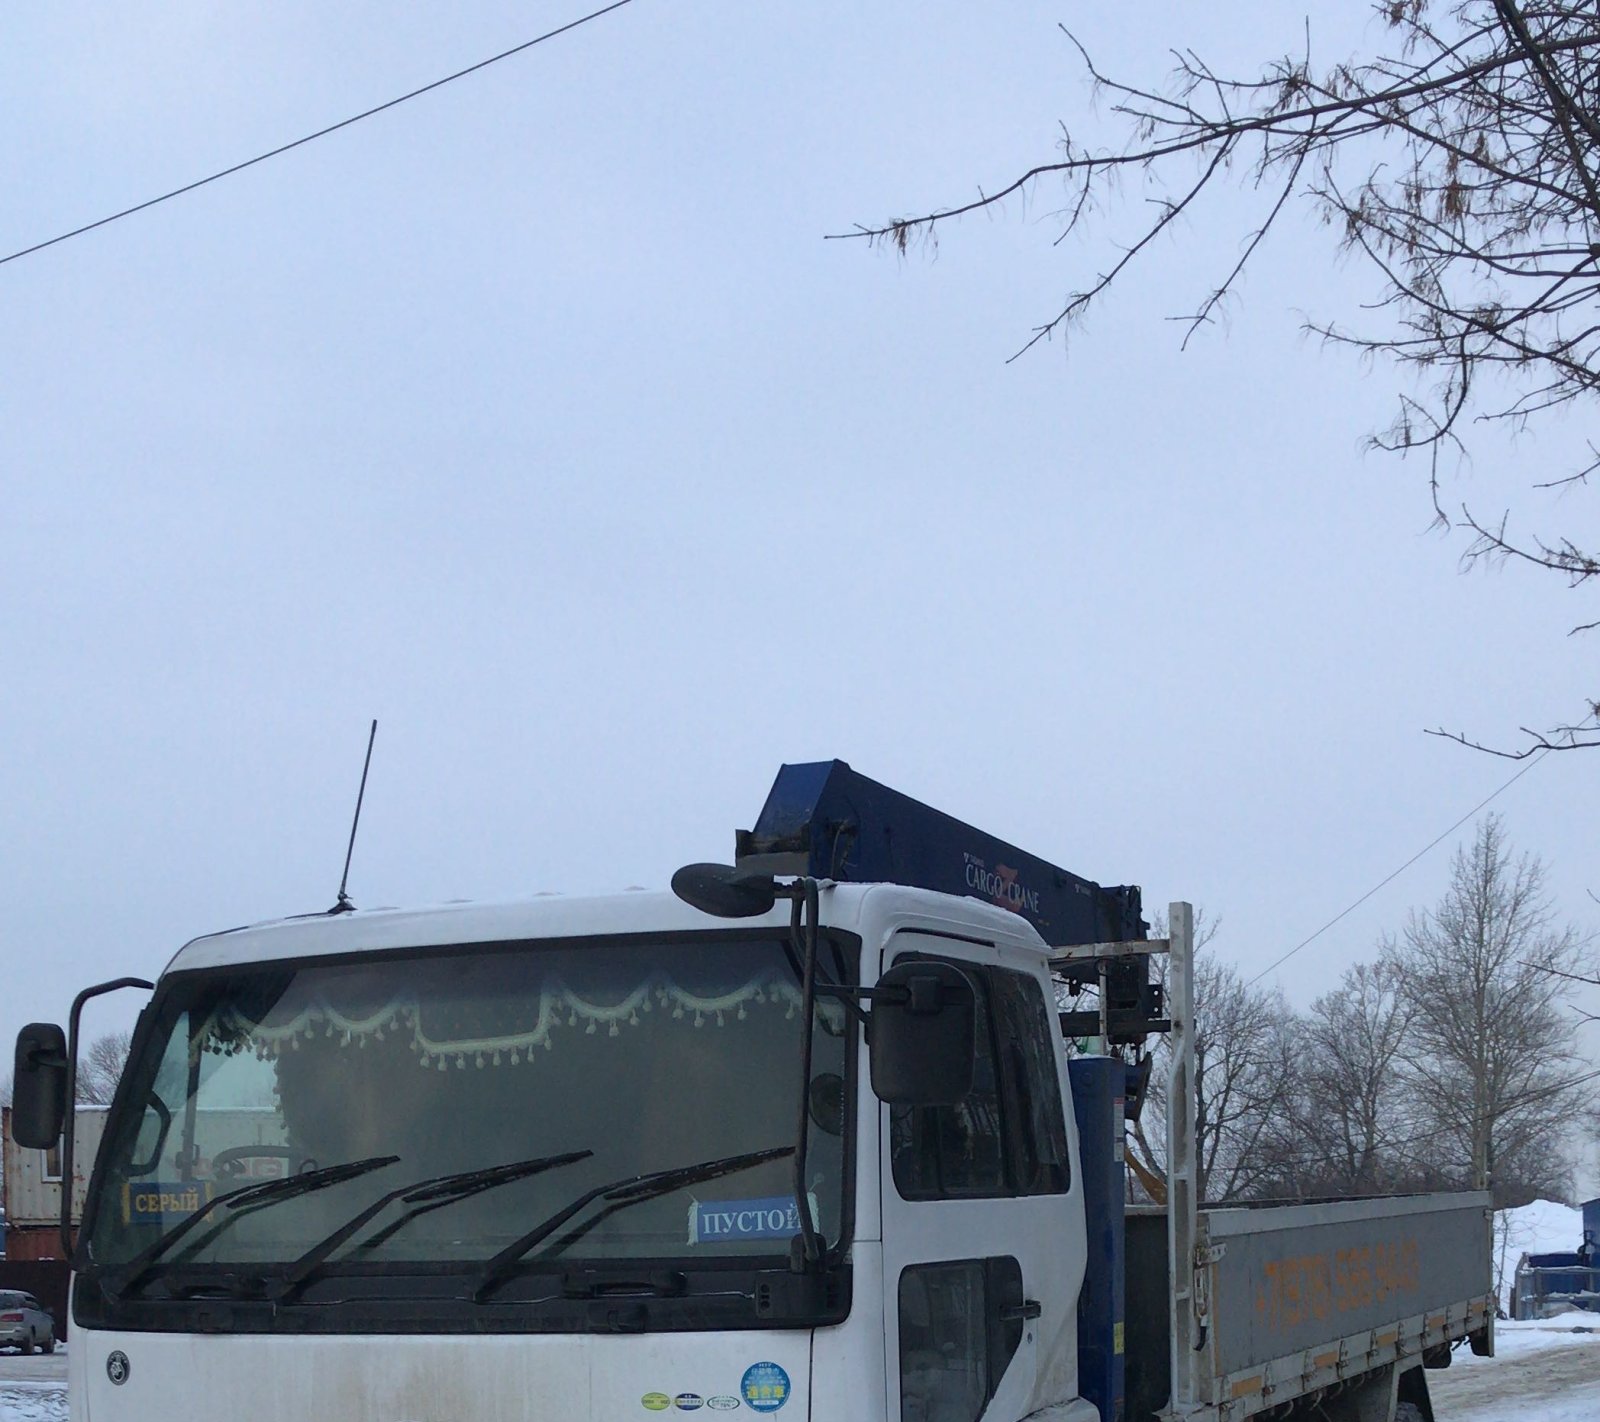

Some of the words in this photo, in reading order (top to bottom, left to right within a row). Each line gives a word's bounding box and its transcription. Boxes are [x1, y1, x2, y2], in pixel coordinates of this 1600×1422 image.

[965, 862, 1003, 898] CARGO
[1007, 880, 1040, 913] CRANE
[135, 1187, 199, 1213] СЕРЫЙ
[703, 1203, 803, 1234] ПУСТОЙ
